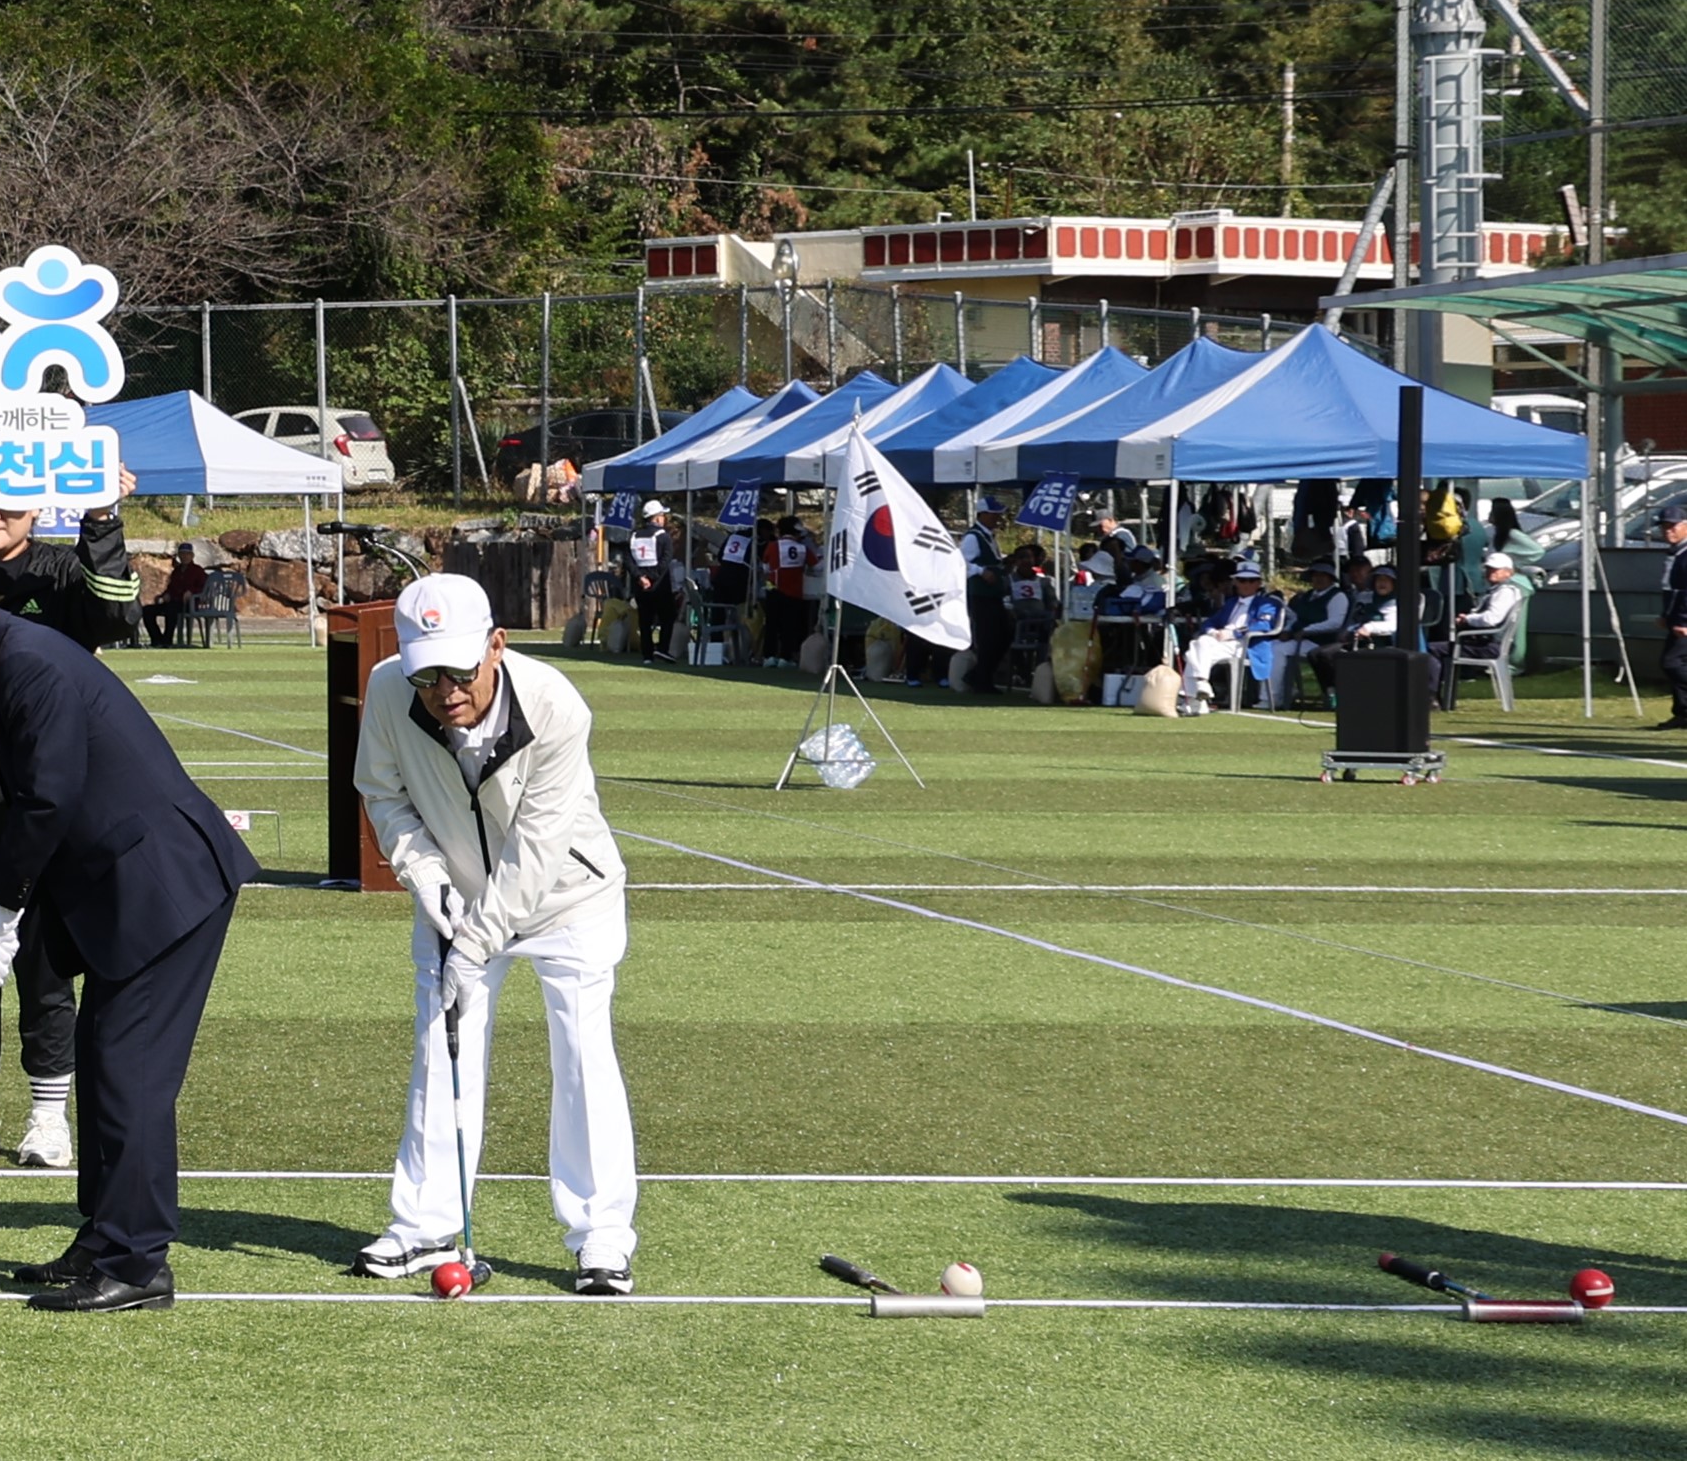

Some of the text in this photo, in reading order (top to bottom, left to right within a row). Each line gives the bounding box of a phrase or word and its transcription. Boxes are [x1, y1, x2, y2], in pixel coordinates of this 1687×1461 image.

[637, 546, 647, 559] 1
[728, 541, 741, 554] 3
[788, 546, 799, 560] 6
[1020, 585, 1034, 598] 3
